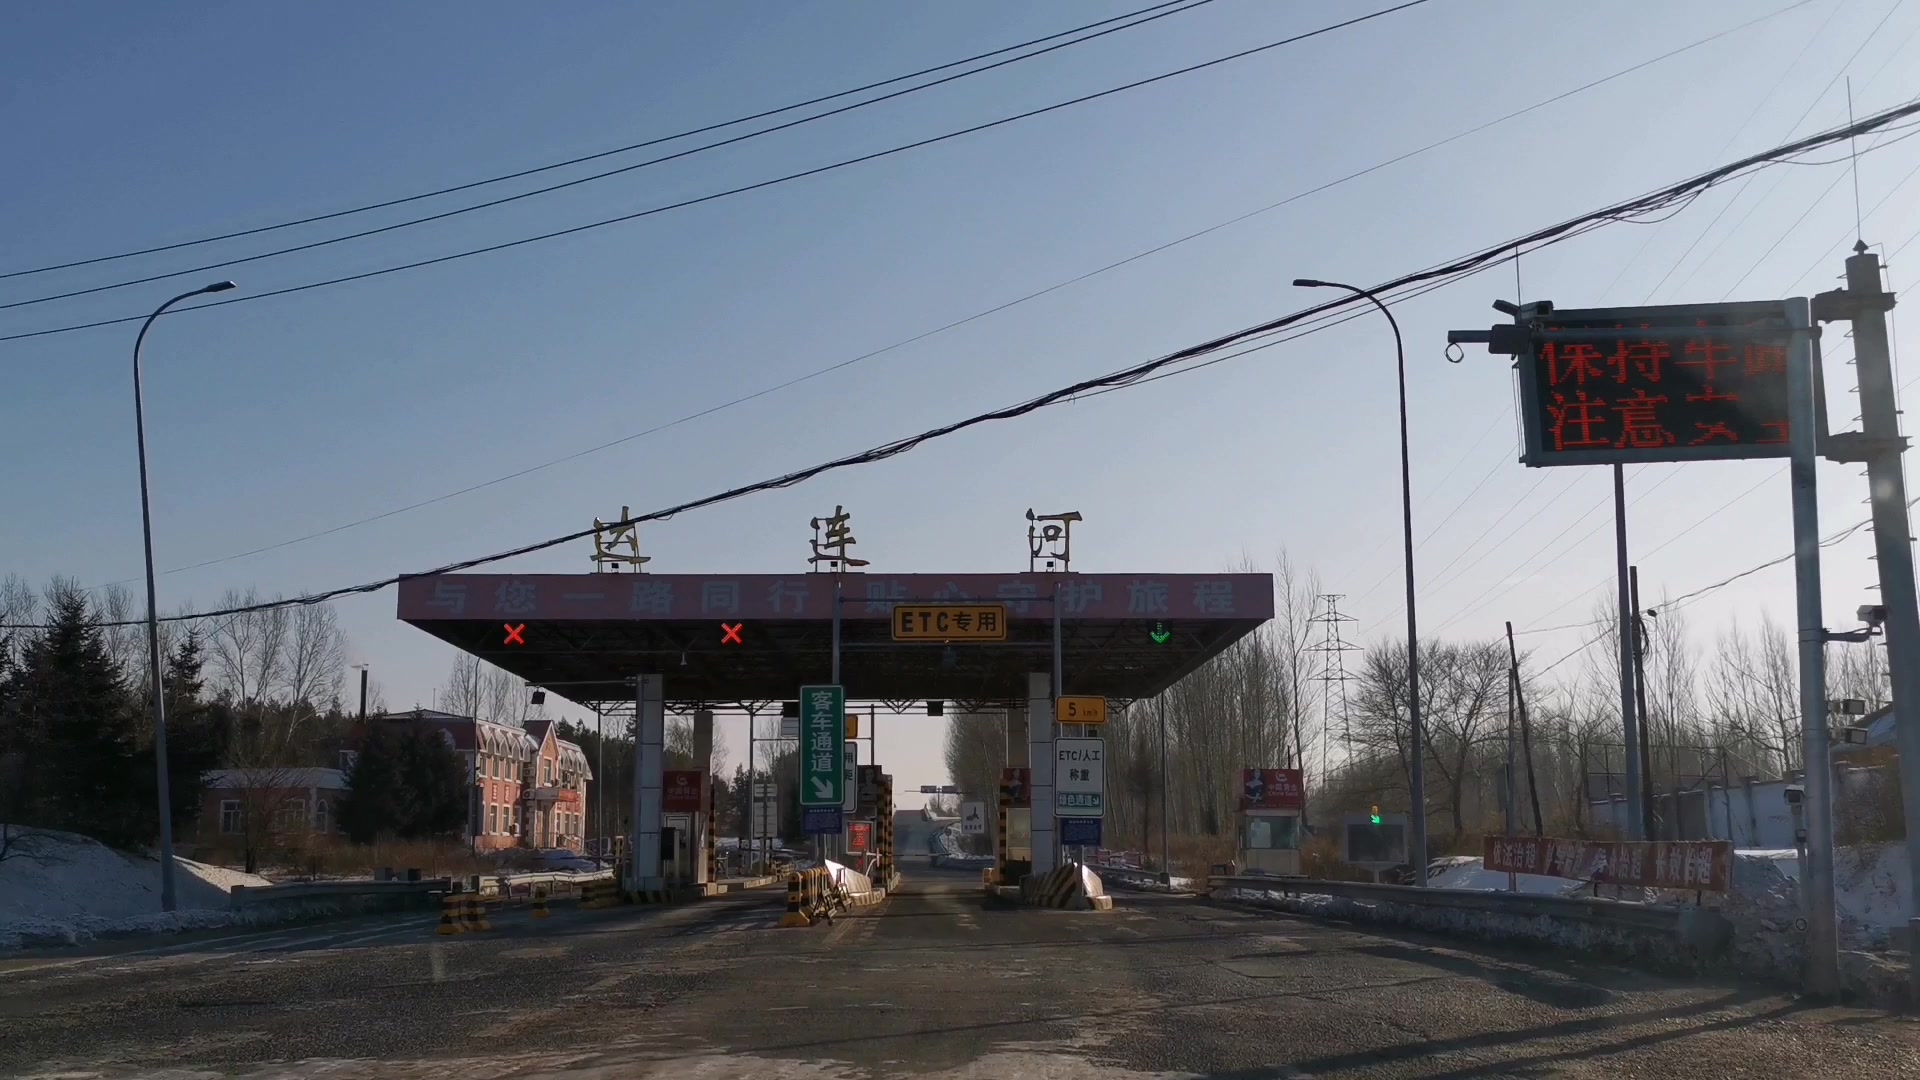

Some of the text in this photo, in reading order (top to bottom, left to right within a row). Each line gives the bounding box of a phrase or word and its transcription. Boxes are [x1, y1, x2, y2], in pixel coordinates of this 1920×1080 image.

[426, 580, 1236, 615] 与您一路同行 贴心守护旅程
[901, 611, 997, 633] ETC专用
[1068, 702, 1077, 717] 5
[811, 691, 834, 772] 客车通道
[1059, 749, 1101, 762] ETC/人工
[1069, 768, 1090, 782] 称重
